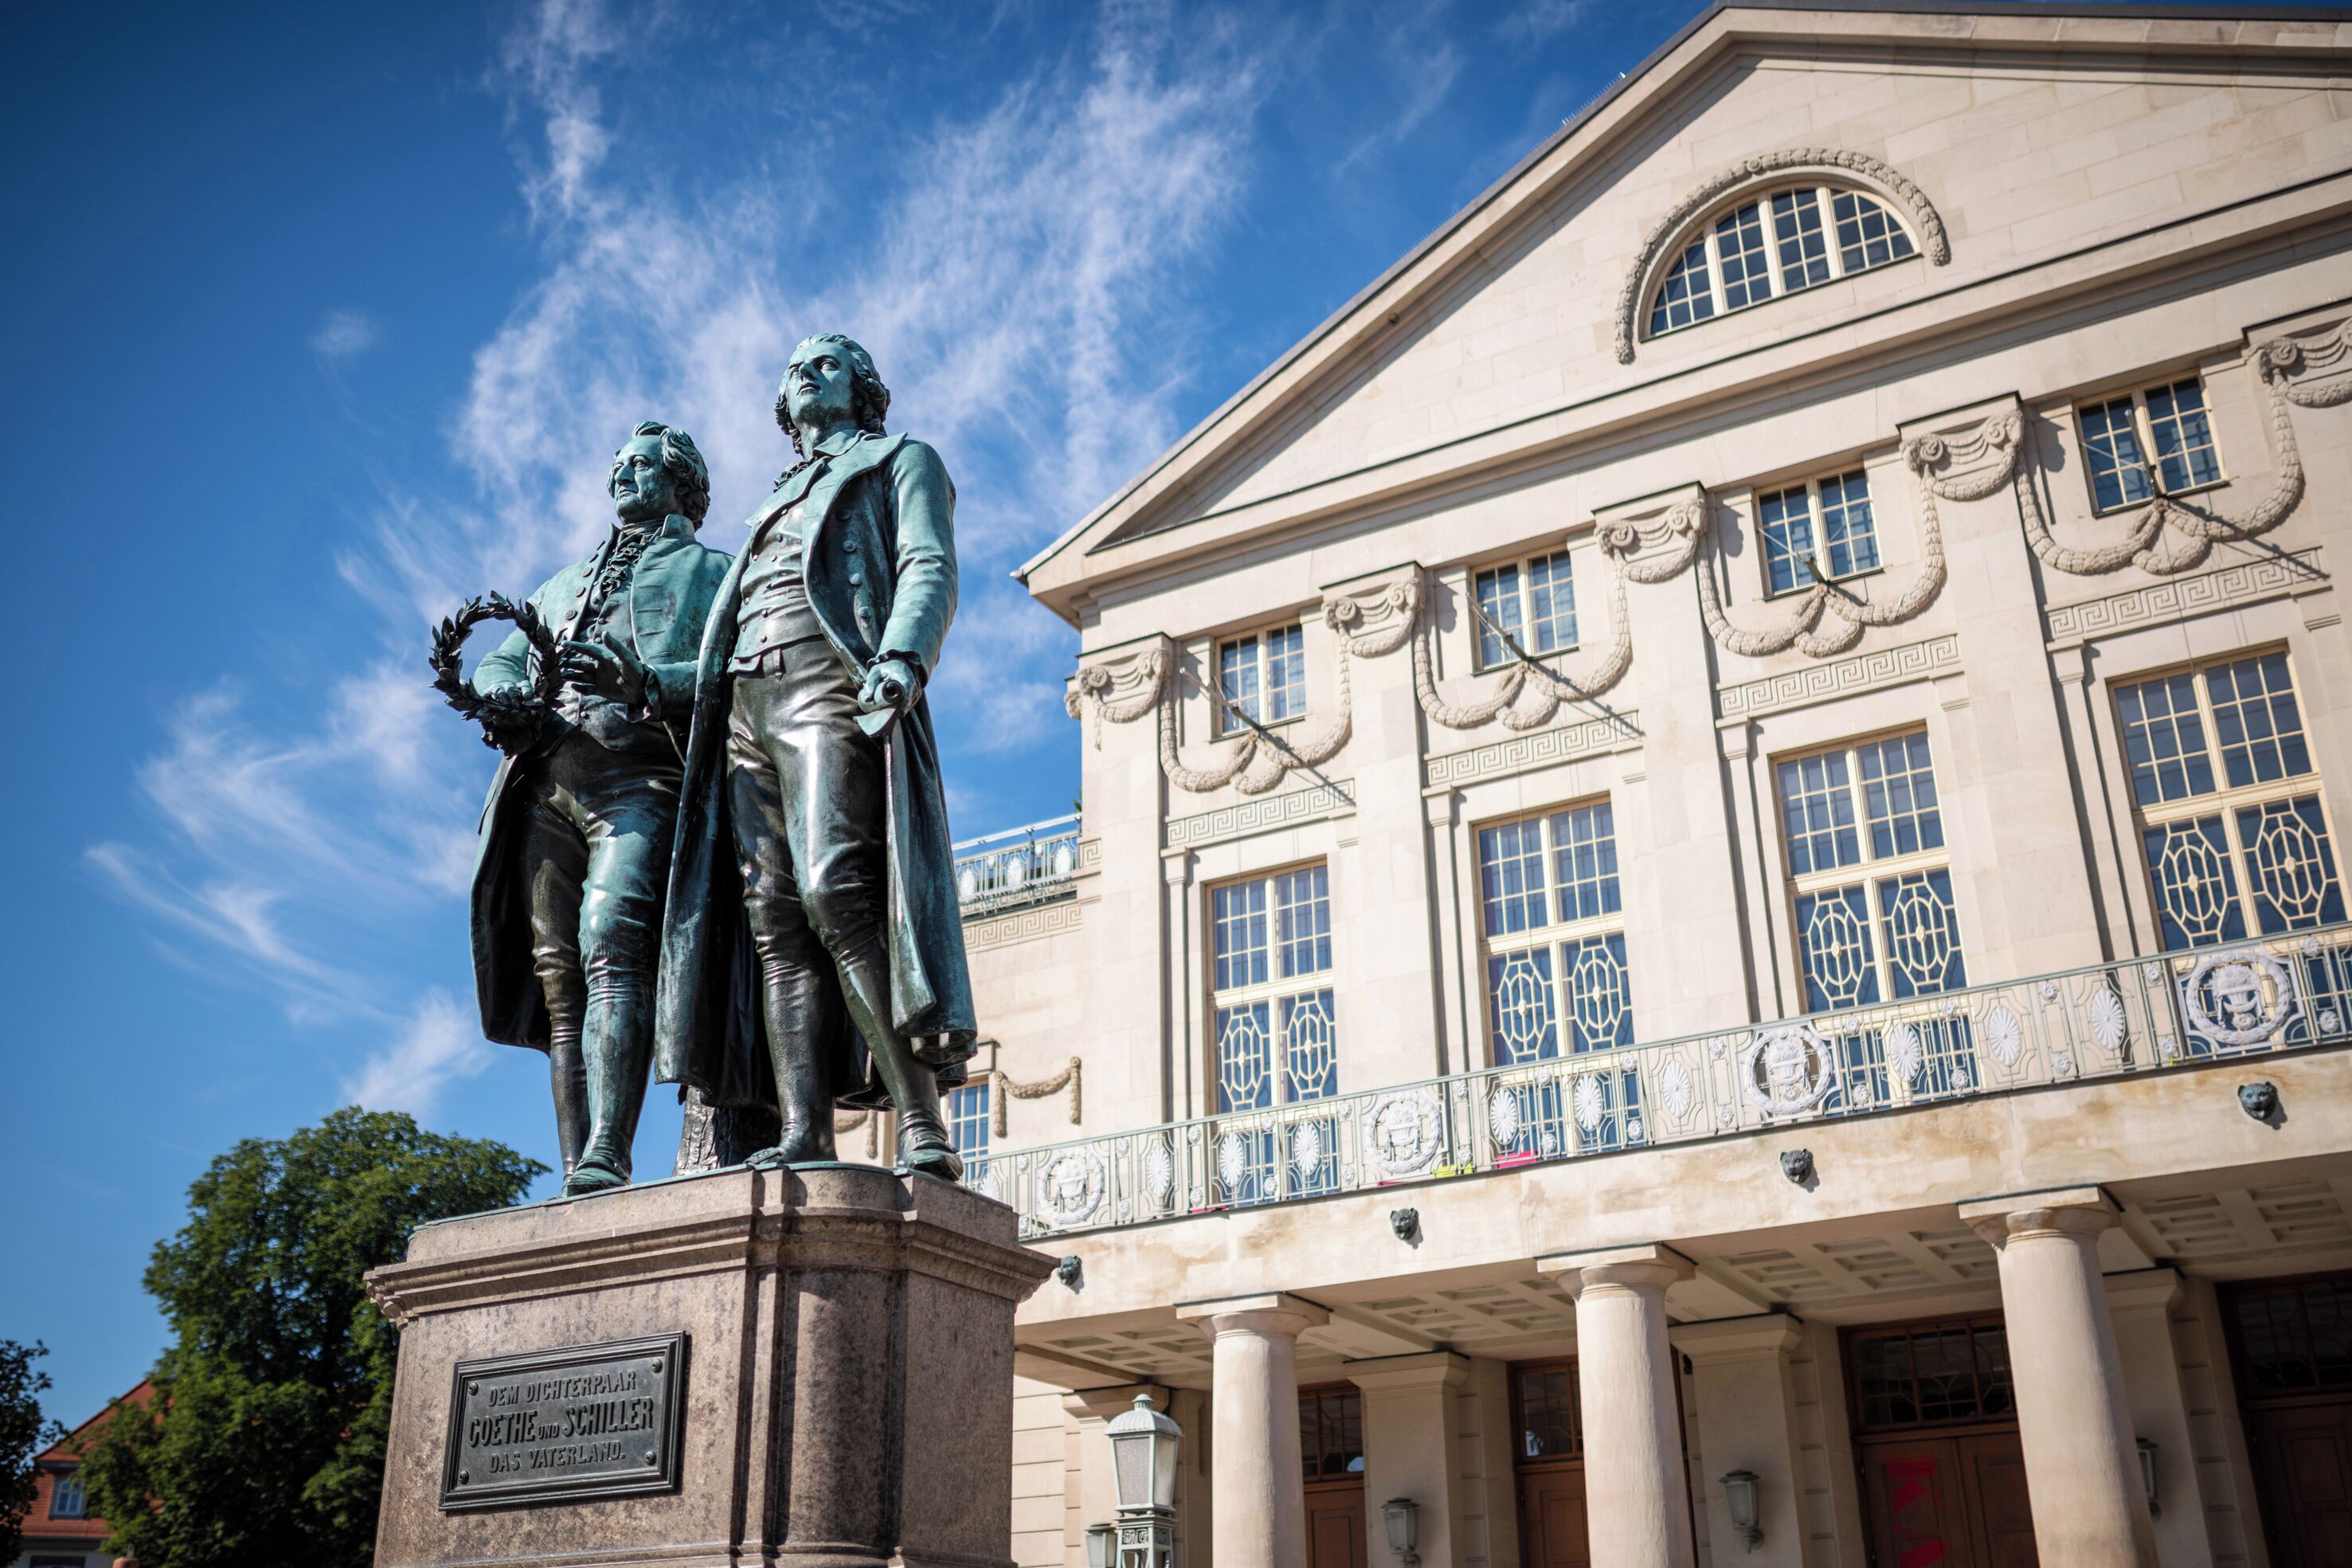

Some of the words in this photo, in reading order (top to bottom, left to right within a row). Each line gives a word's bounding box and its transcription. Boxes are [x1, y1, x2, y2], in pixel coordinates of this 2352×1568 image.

[488, 1386, 519, 1407] DEM
[526, 1371, 636, 1403] DICHTERPAAR
[468, 1410, 538, 1448] GOETHE
[538, 1424, 558, 1440] UND
[562, 1397, 654, 1437] SCHILLER
[489, 1453, 520, 1473] DAS
[529, 1441, 626, 1468] VATERLAND.
